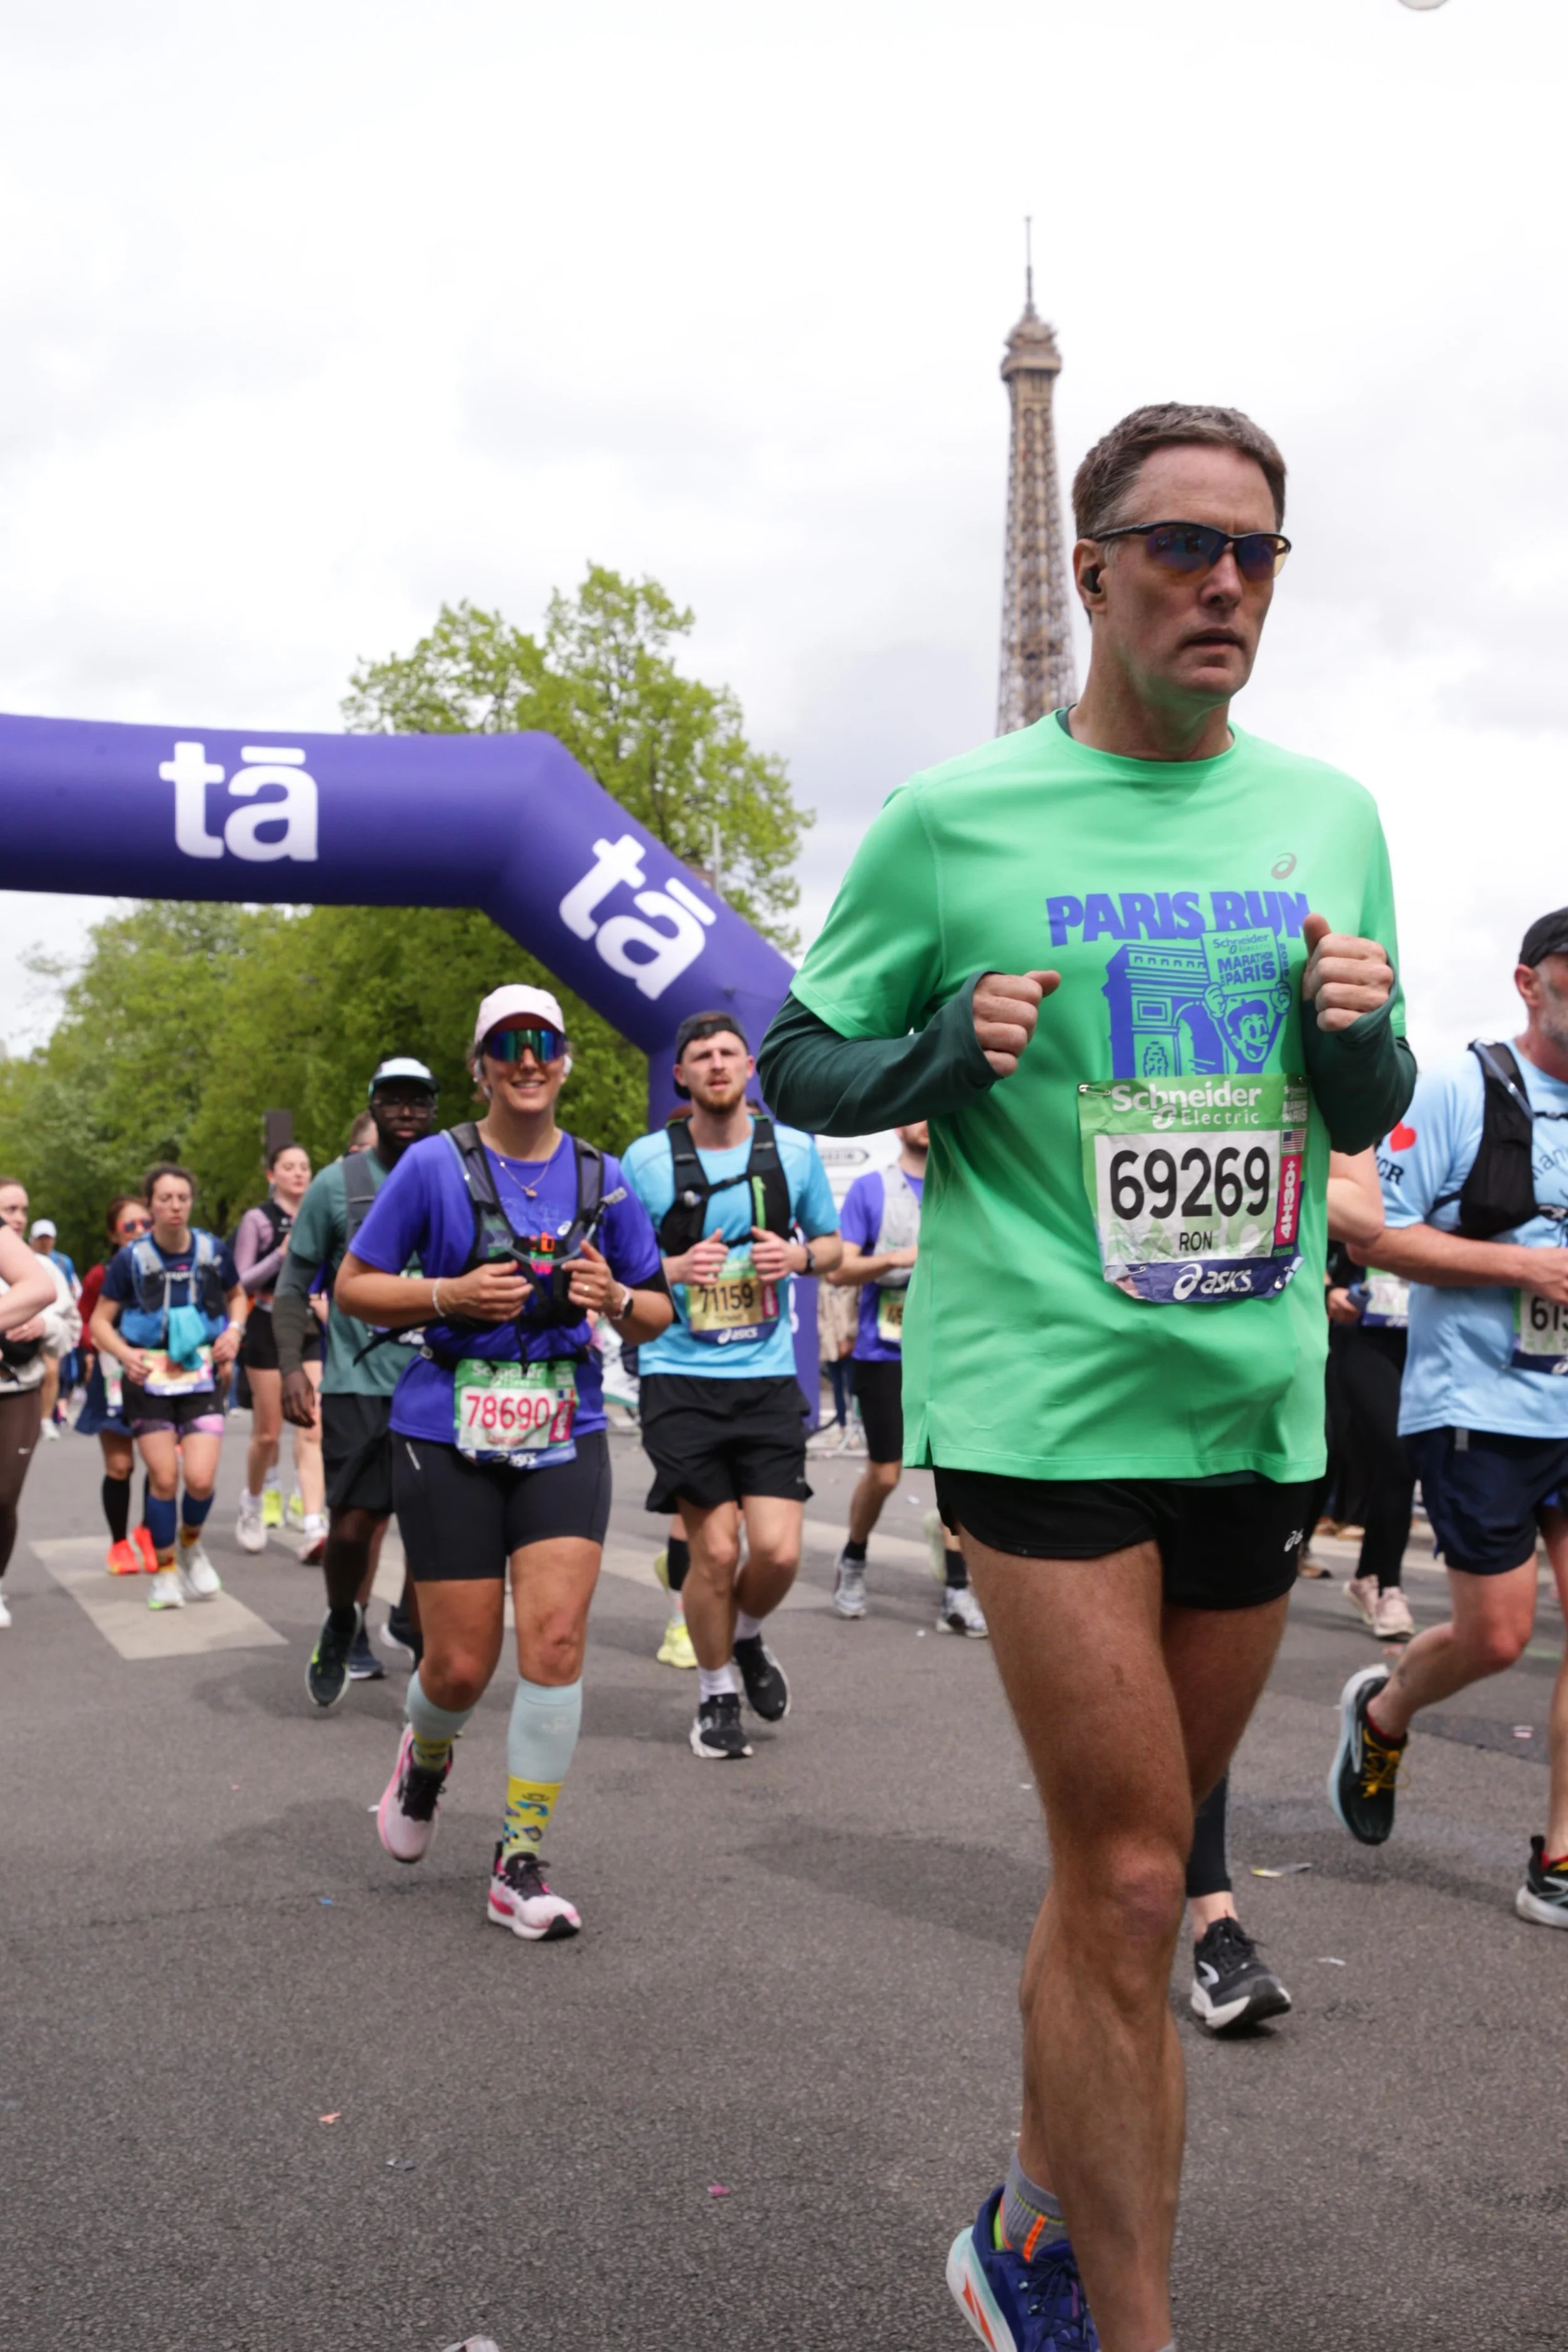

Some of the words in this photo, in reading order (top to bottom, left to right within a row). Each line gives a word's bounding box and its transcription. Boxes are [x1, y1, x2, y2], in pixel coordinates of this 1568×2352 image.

[1046, 891, 1205, 947] PARIS
[1209, 891, 1310, 938] RUN
[1213, 933, 1269, 948] Schneider
[1225, 960, 1276, 986] PARIS
[1111, 1081, 1262, 1112] Schneider
[1182, 1109, 1259, 1126] Electric
[1110, 1147, 1270, 1221] 69269
[1281, 1160, 1296, 1239] 4H30+
[1179, 1231, 1212, 1251] RON
[698, 1283, 755, 1313] 71159
[466, 1395, 551, 1430] 78690
